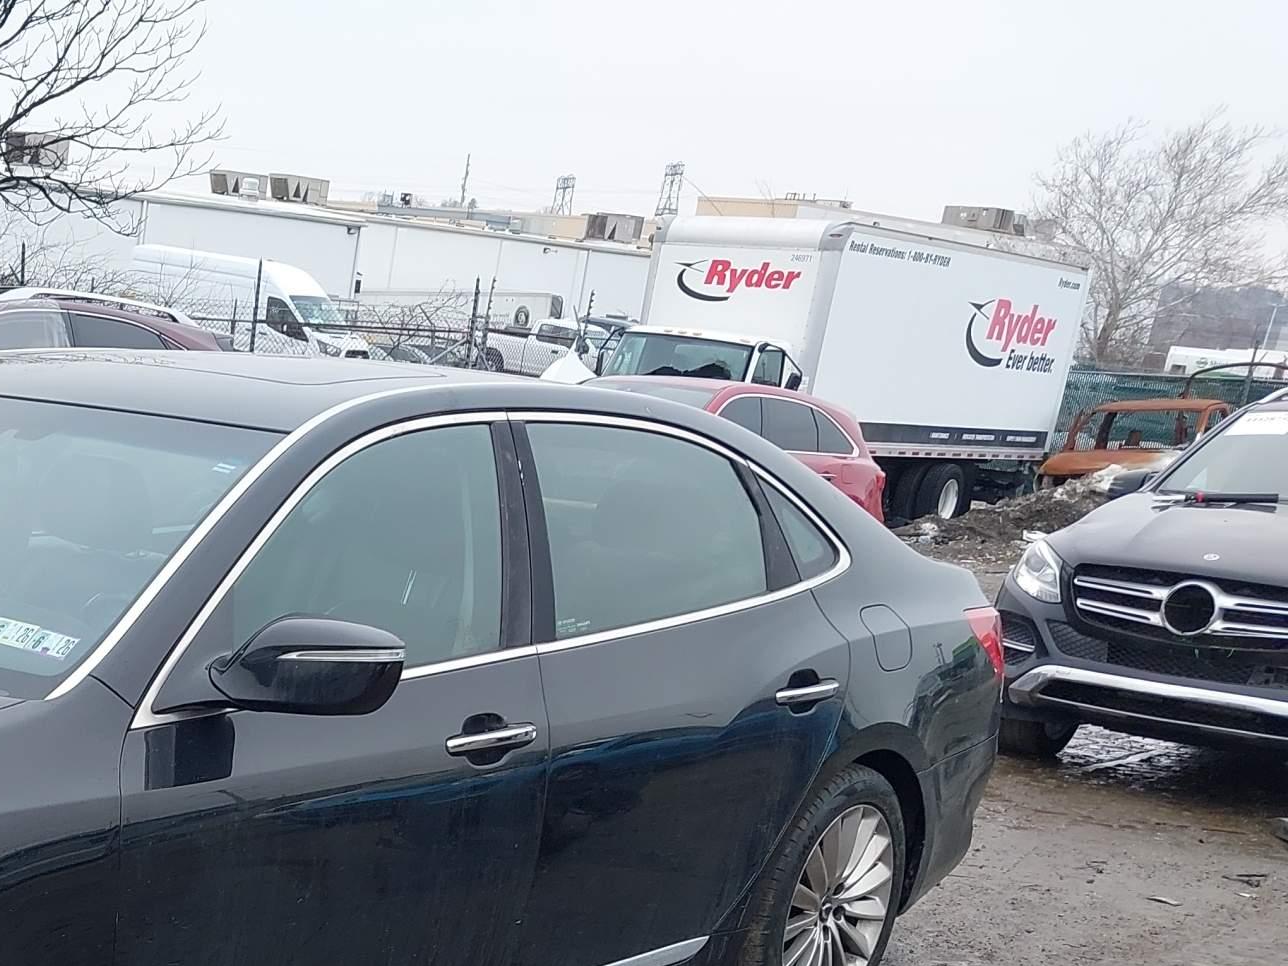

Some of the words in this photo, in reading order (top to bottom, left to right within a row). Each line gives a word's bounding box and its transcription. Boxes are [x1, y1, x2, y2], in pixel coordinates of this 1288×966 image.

[848, 240, 869, 254] Rental
[868, 243, 908, 260] Reservations:
[704, 259, 802, 293] Ryder
[986, 298, 1058, 352] Ryder
[1005, 349, 1028, 370] Ever
[1026, 351, 1055, 374] better.
[55, 639, 75, 656] 26
